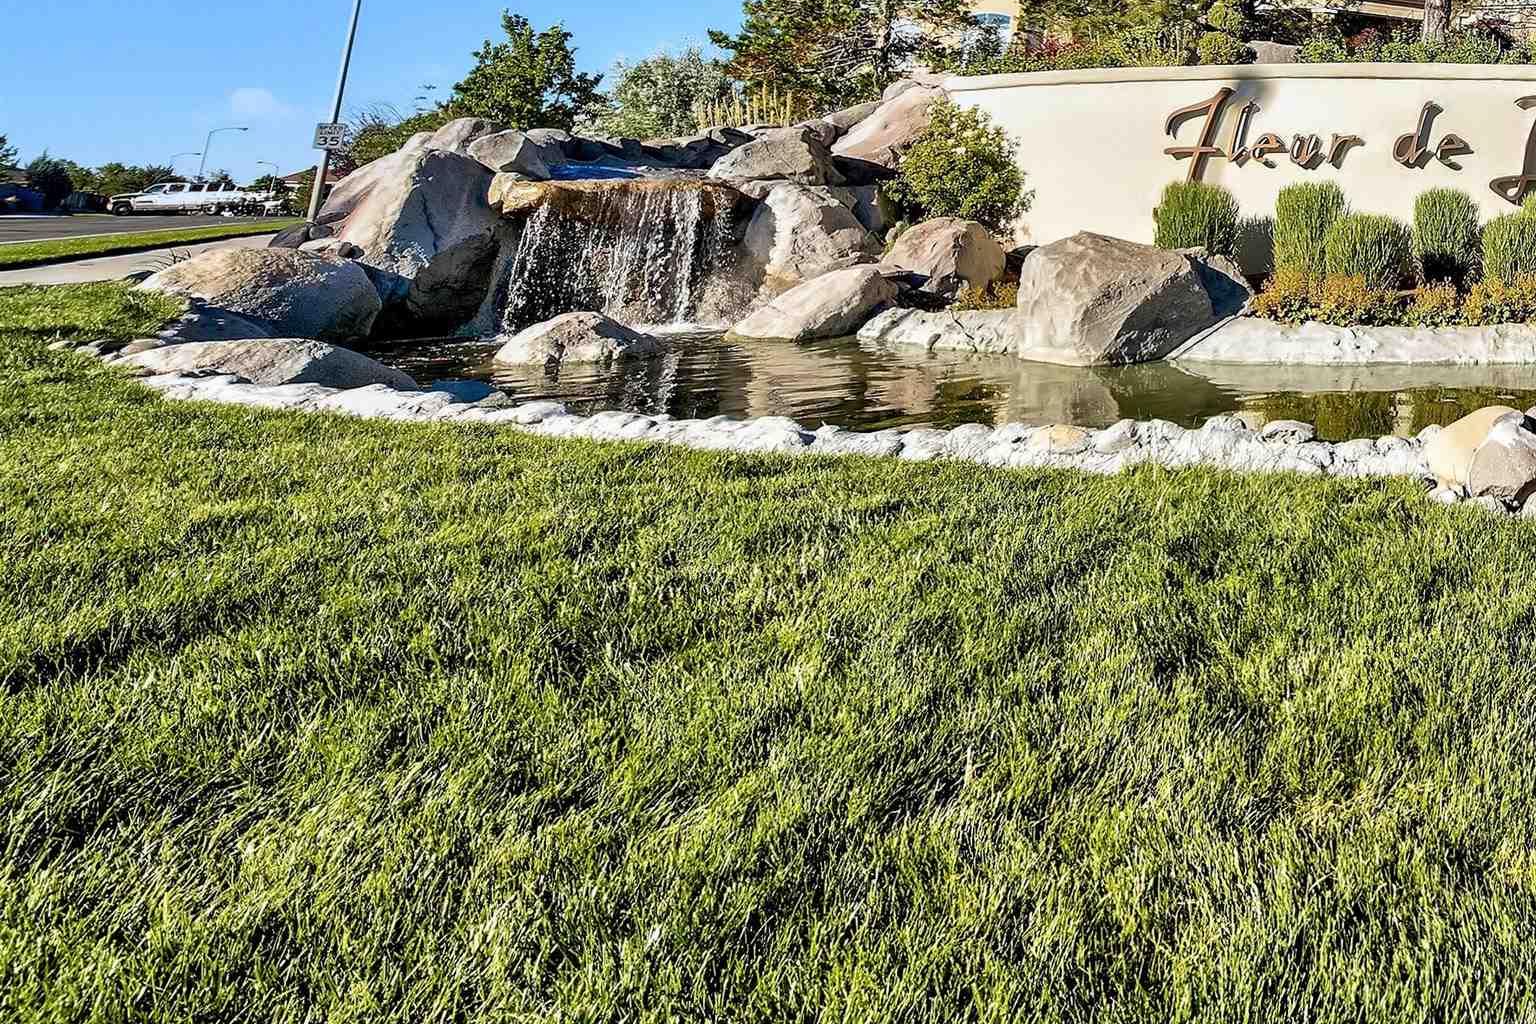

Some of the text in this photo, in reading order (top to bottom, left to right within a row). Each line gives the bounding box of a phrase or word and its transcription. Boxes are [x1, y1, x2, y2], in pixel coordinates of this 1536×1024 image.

[317, 136, 340, 146] 35
[1164, 87, 1366, 184] Fleur
[1393, 101, 1475, 171] de
